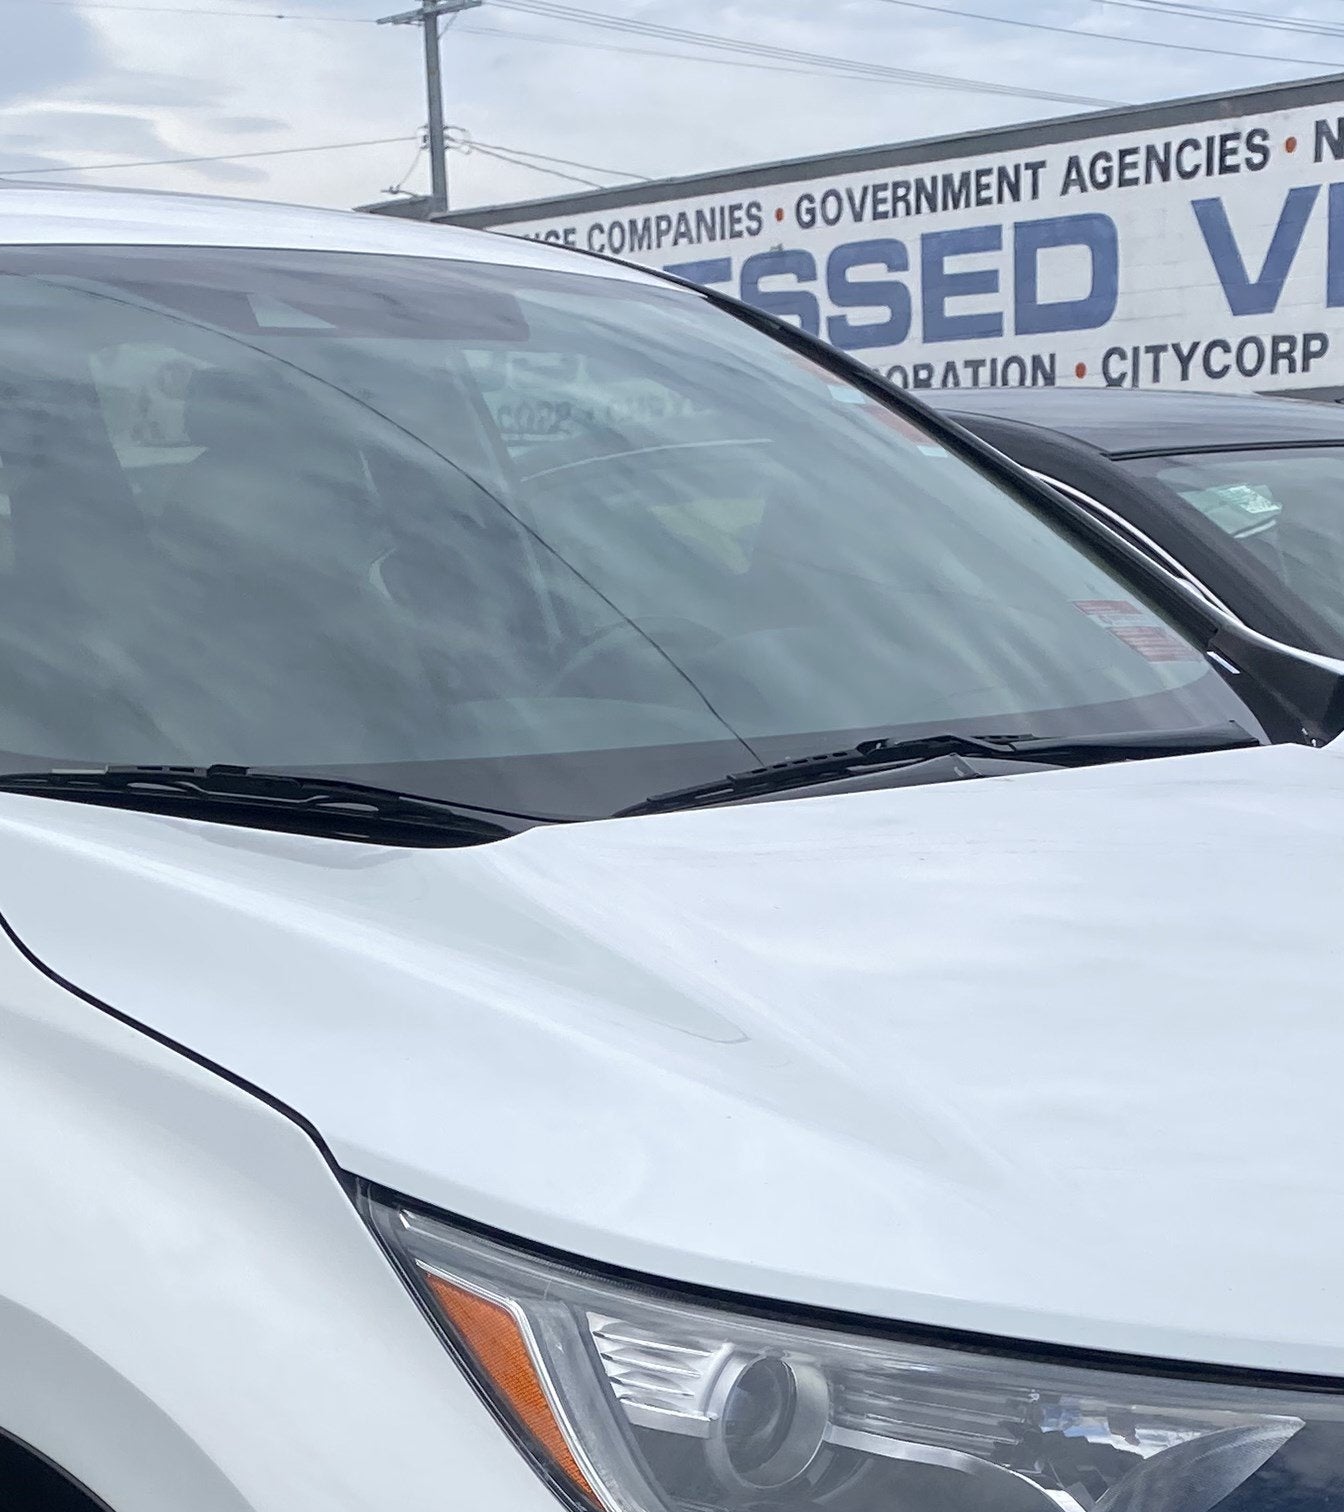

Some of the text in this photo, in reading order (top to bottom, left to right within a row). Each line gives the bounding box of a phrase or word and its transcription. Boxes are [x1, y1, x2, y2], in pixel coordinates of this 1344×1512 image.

[587, 201, 763, 253] COMPANIES
[796, 161, 1046, 229] GOVERNMENT
[1061, 128, 1270, 196] AGENCIES
[662, 212, 1118, 350] SSED
[872, 352, 1055, 389] ORATION
[1102, 331, 1329, 389] CITYCORP
